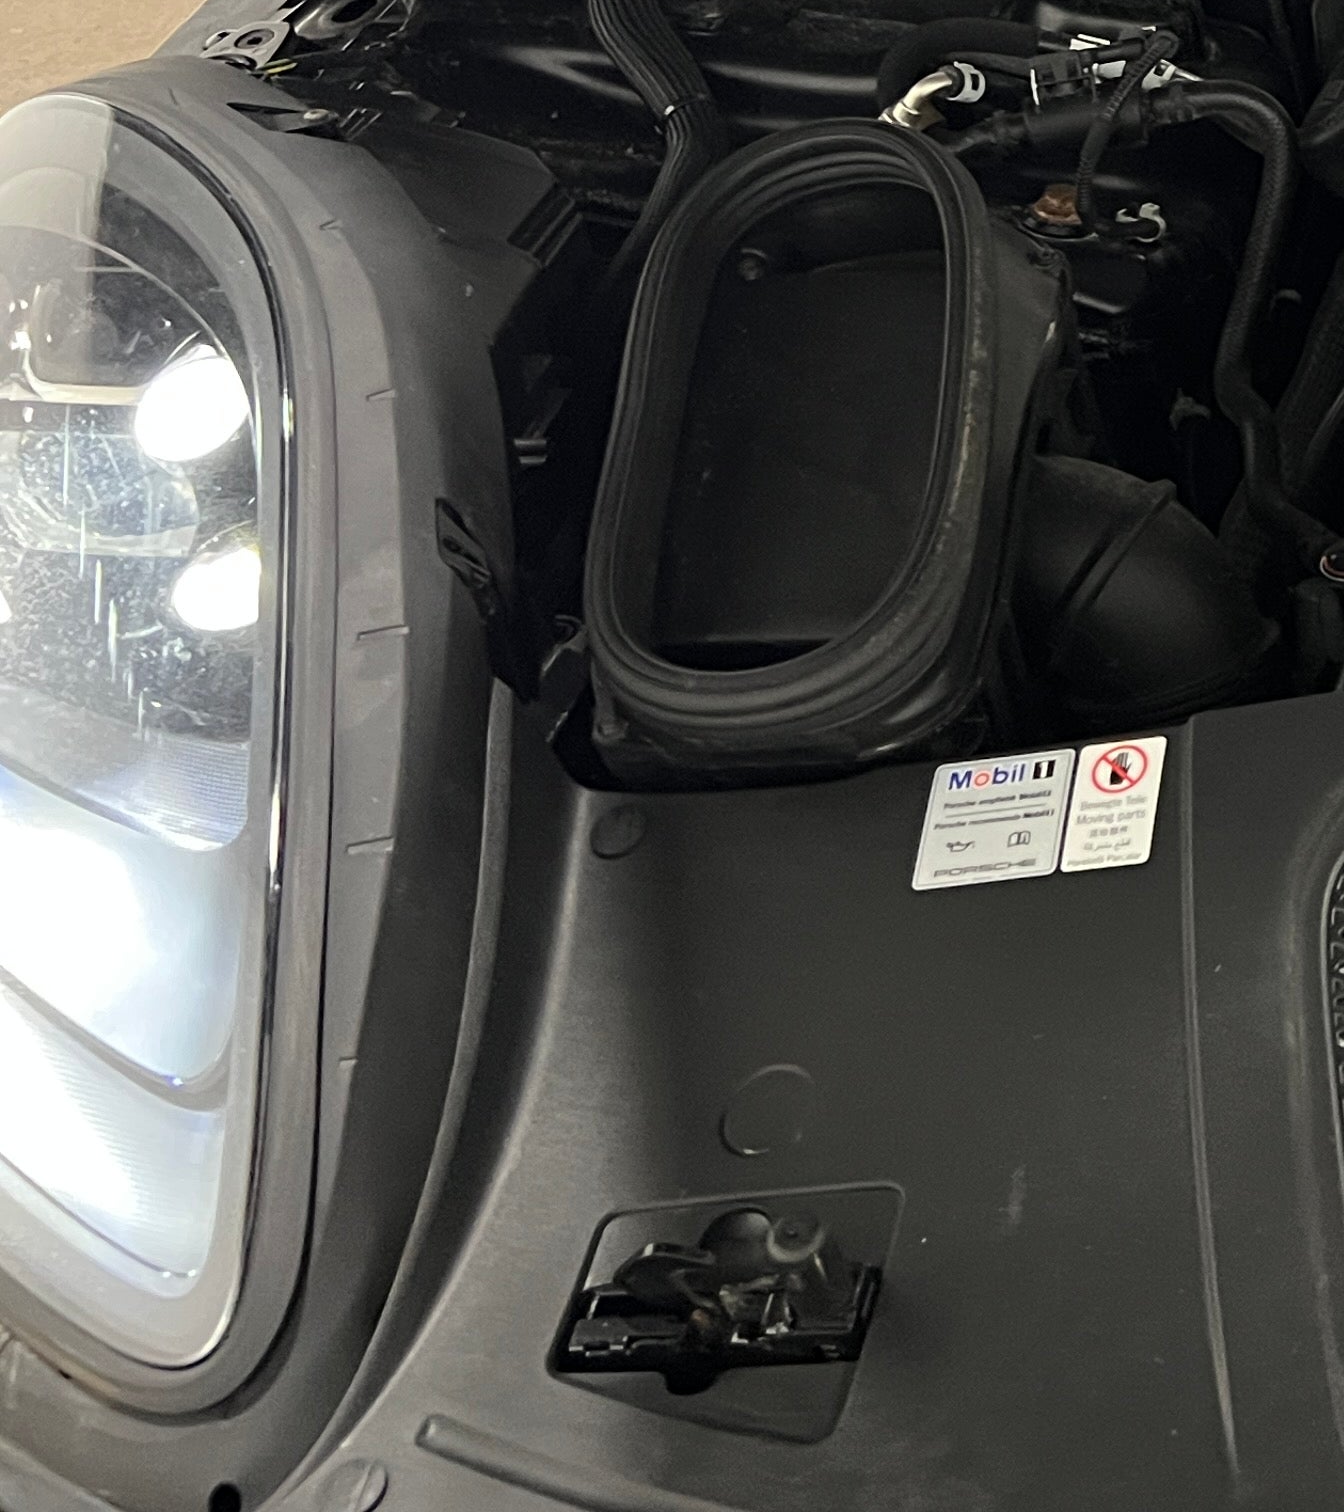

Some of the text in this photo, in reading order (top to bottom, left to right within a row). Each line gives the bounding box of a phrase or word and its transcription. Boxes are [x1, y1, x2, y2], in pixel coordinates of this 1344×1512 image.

[949, 763, 1026, 790] Mobil
[1117, 809, 1146, 821] parts
[934, 858, 1036, 878] PORSCHE
